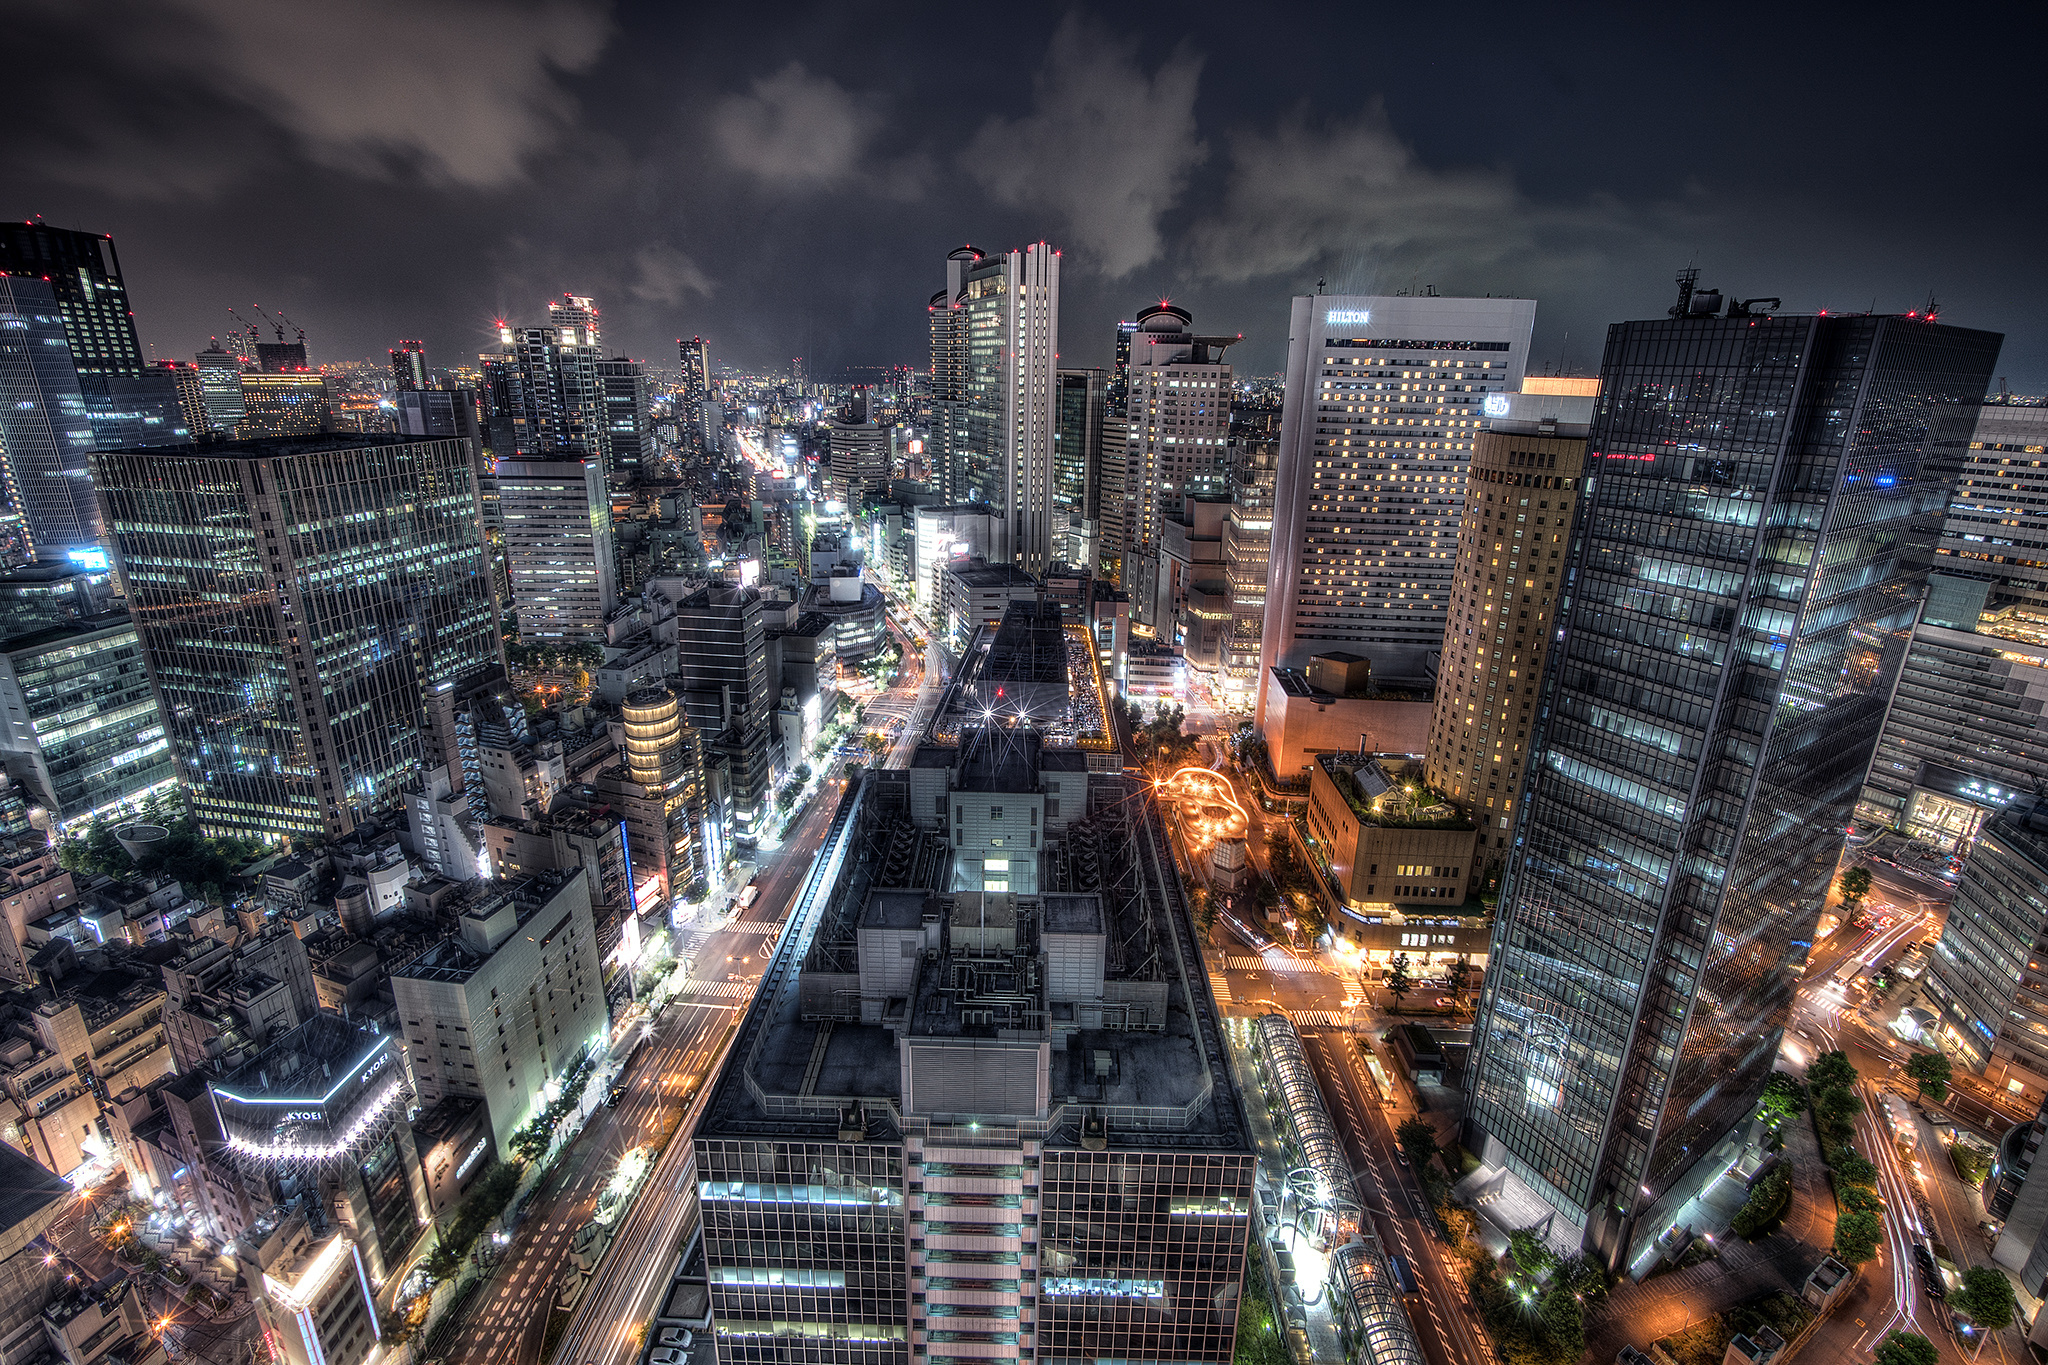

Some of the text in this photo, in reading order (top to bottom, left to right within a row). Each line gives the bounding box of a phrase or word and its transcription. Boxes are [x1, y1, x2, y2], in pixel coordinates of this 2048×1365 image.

[1328, 310, 1370, 324] HILTON
[1959, 787, 1987, 799] OSAKA
[1990, 796, 2008, 805] STA
[361, 1052, 389, 1083] KYOEI
[287, 1111, 321, 1121] KYOEI
